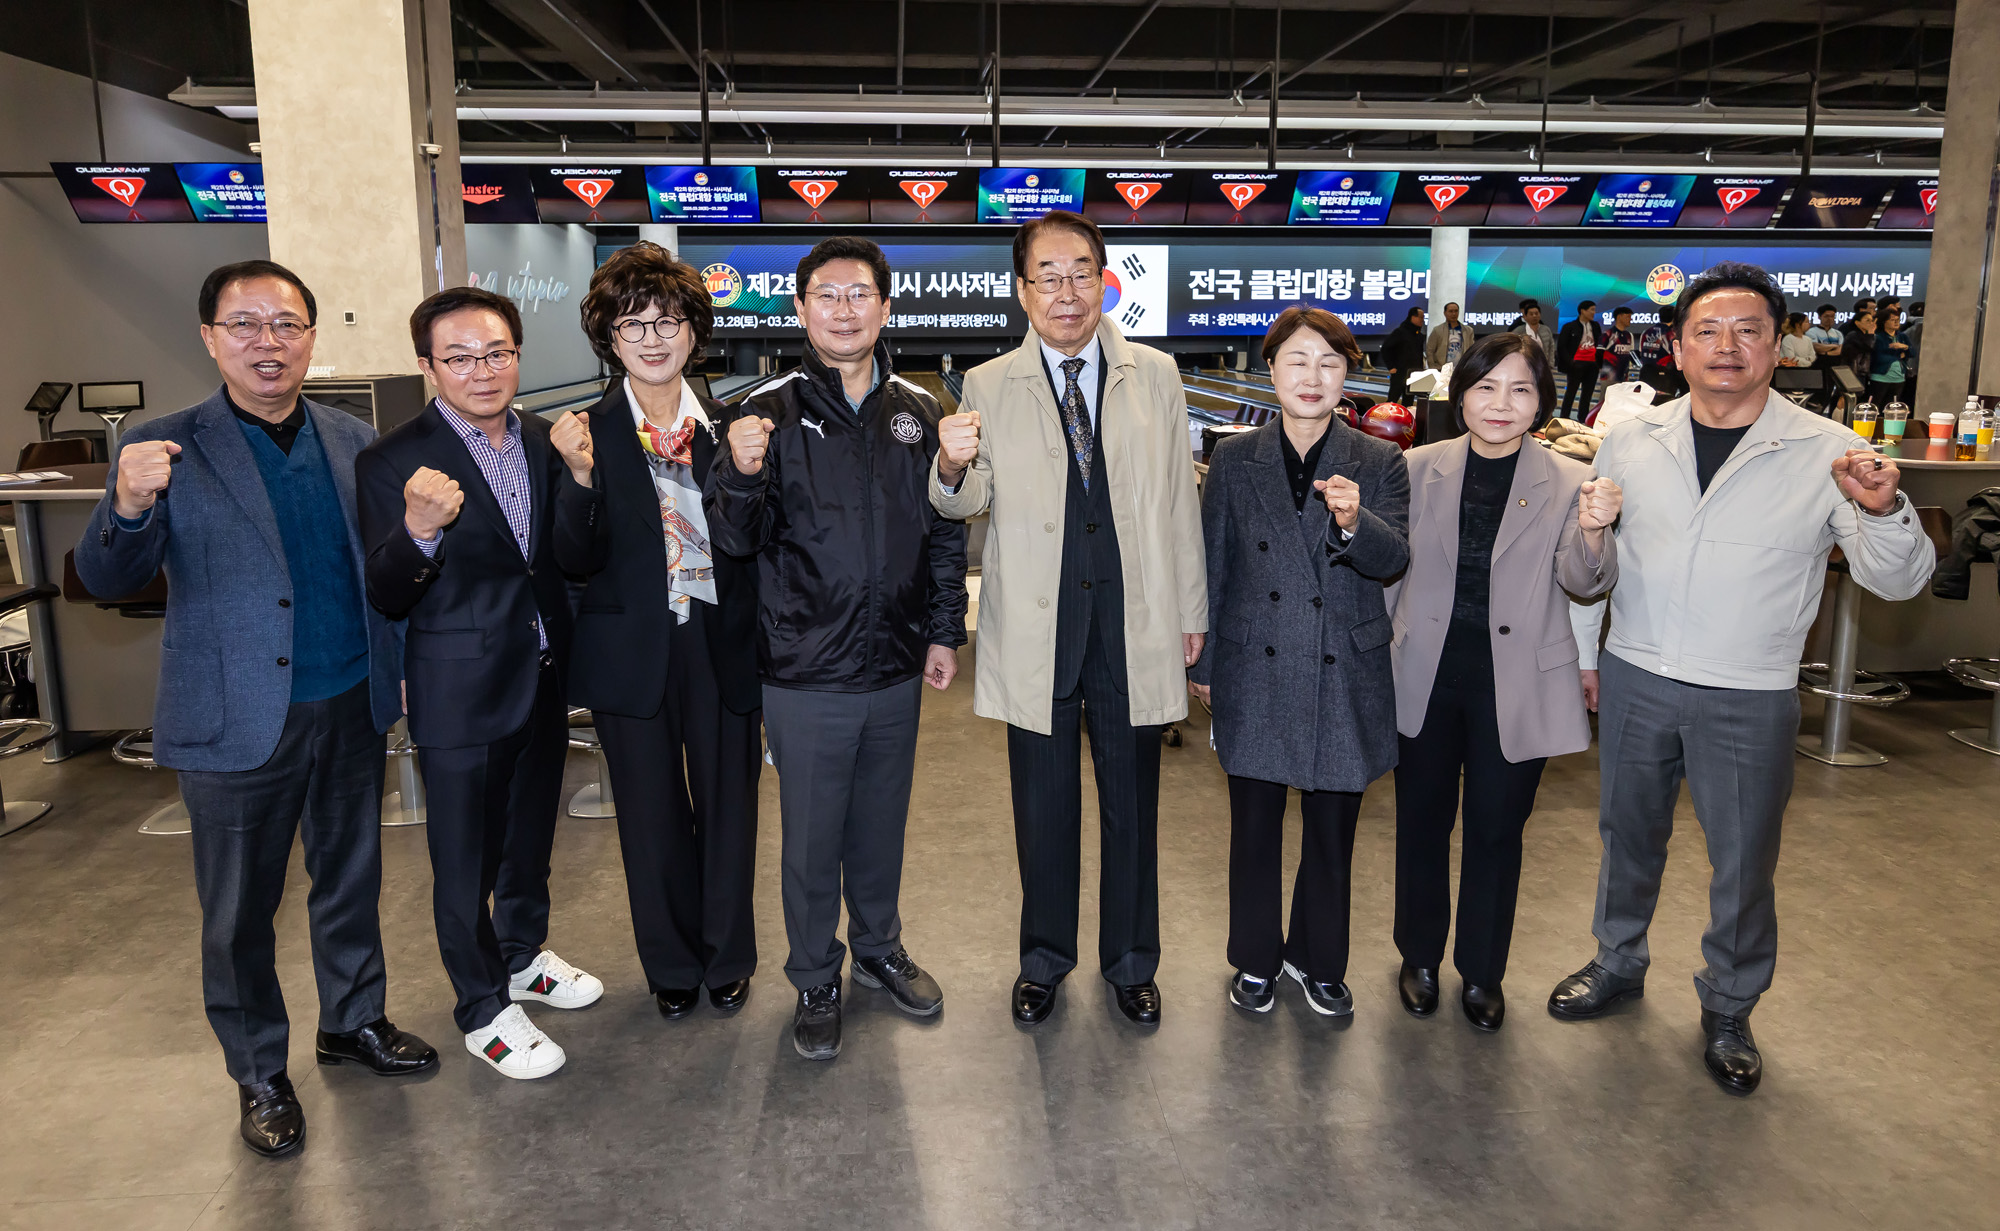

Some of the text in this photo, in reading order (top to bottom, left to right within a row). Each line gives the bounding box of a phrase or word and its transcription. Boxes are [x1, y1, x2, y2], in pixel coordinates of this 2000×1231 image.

[254, 190, 266, 201] 볼
[659, 192, 747, 202] 전국 클럽대항 볼링대회
[989, 194, 1072, 204] 전국 클럽대항 볼링대회
[925, 272, 1012, 298] 시사저널
[1188, 269, 1243, 300] 전국
[1249, 269, 1355, 300] 클럽대항
[1840, 272, 1914, 297] 시사저널
[897, 314, 939, 328] 볼토피아
[1188, 313, 1209, 326] 주최
